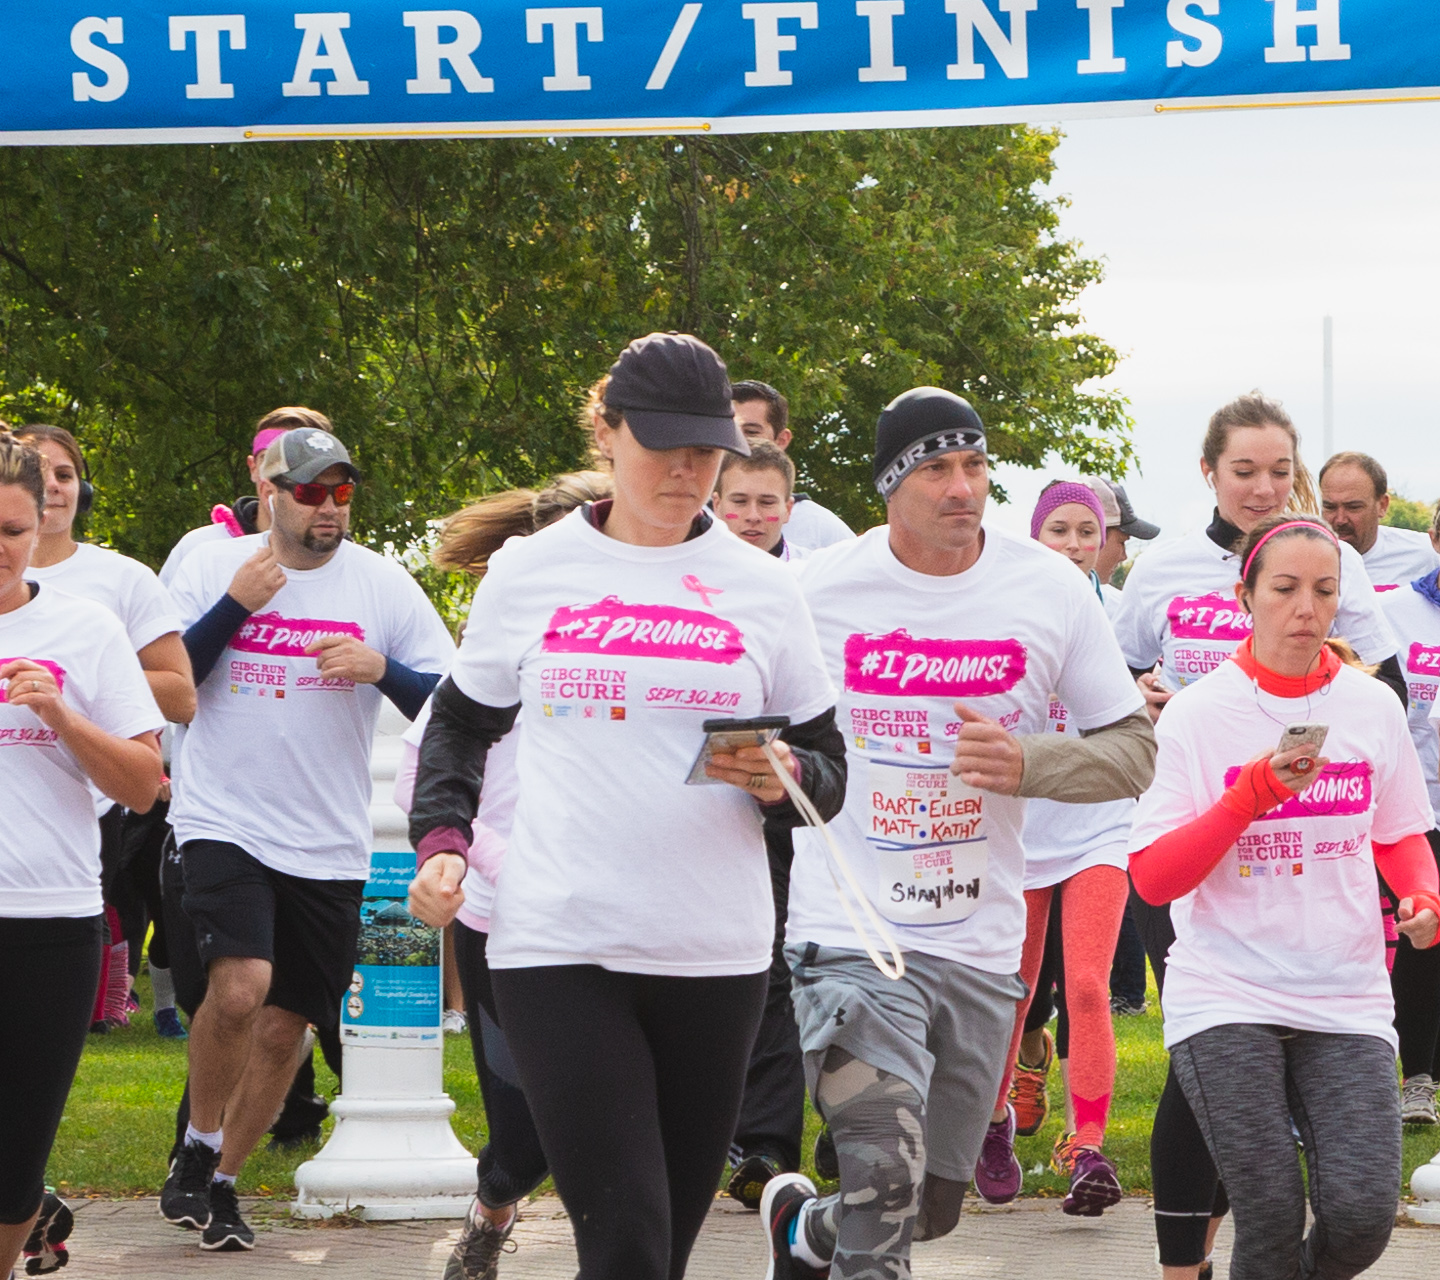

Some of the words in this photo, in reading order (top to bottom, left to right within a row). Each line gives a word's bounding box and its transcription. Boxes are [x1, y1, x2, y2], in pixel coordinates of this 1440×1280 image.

[1174, 650, 1200, 660] CIBC
[230, 661, 260, 672] CIBC
[261, 664, 286, 674] RUN
[244, 672, 286, 686] CURE
[541, 668, 581, 681] CIBC
[585, 668, 627, 683] RUN
[559, 682, 626, 700] CURE
[850, 708, 891, 721] CIBC
[894, 710, 928, 722] RUN
[871, 722, 930, 738] CURE
[917, 780, 947, 788] CURE
[872, 791, 922, 815] BART
[929, 796, 982, 818] EILEEN
[873, 815, 920, 839] MATT
[931, 818, 982, 842] KATHY
[1236, 833, 1271, 847] CIBC
[1273, 831, 1303, 843] RUN
[1256, 844, 1303, 861] CURE
[925, 856, 953, 868] CURE
